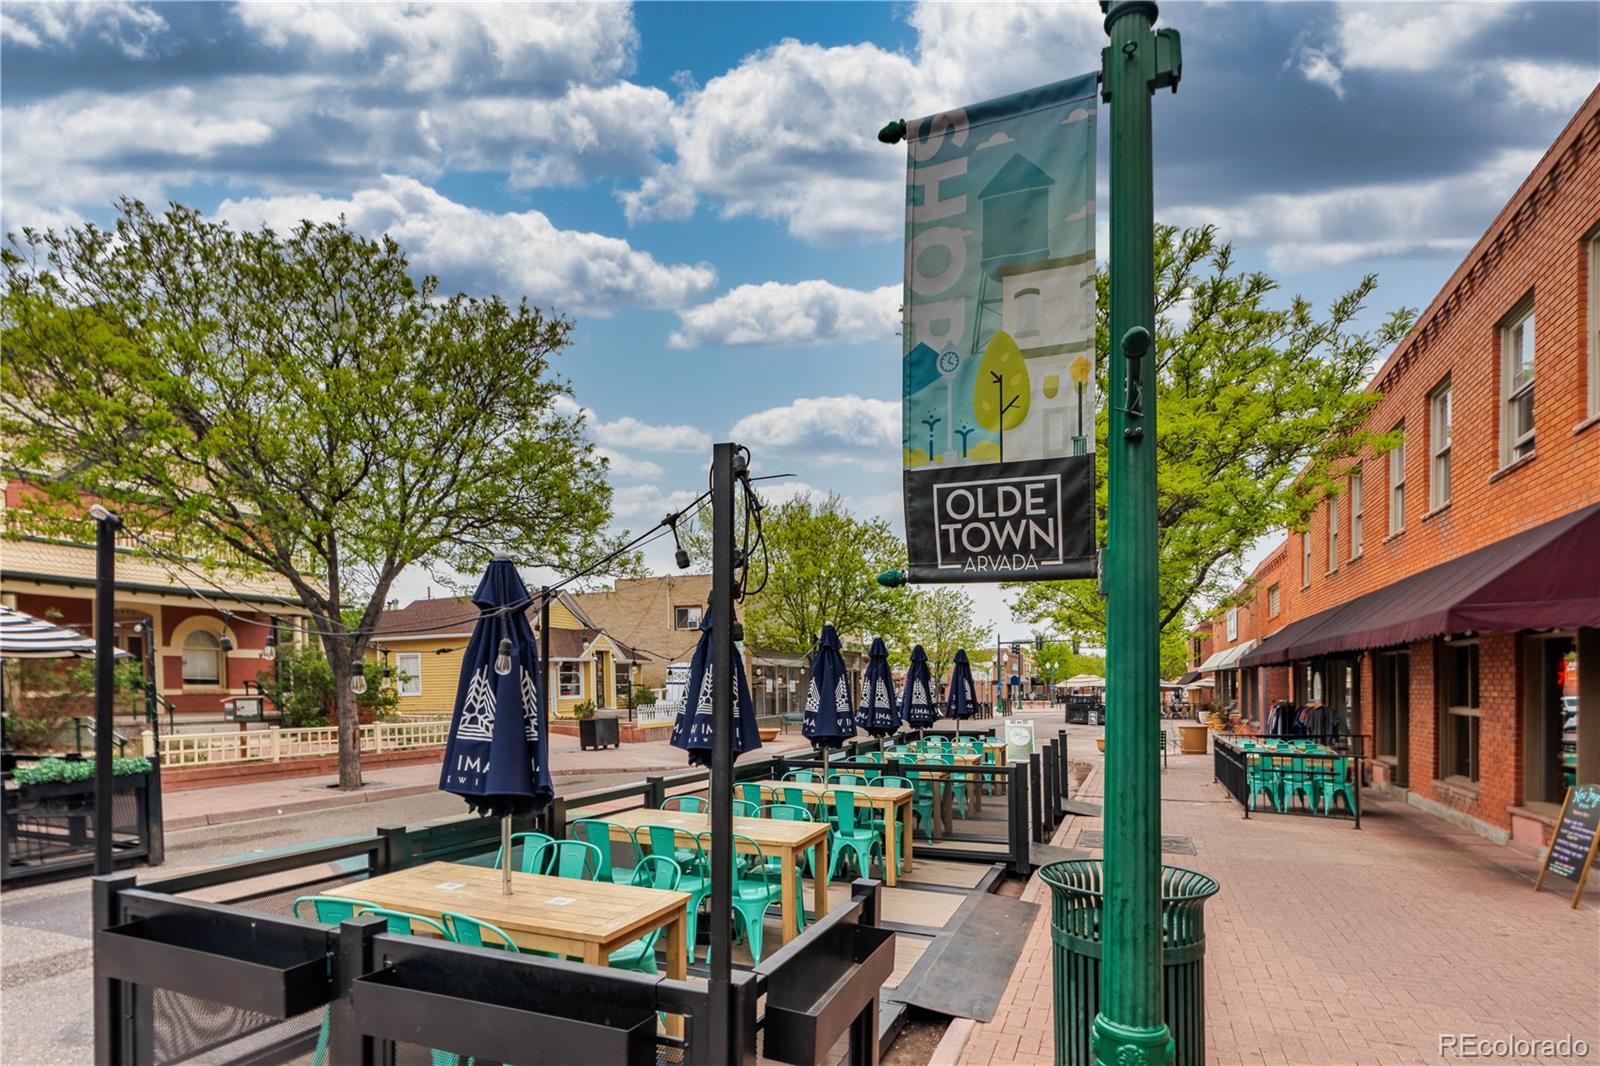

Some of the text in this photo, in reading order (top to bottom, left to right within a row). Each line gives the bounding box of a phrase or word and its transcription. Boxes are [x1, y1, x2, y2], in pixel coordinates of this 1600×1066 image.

[946, 483, 1046, 520] OLDE
[941, 517, 1055, 553] TOWN
[963, 553, 1039, 573] ARVADA
